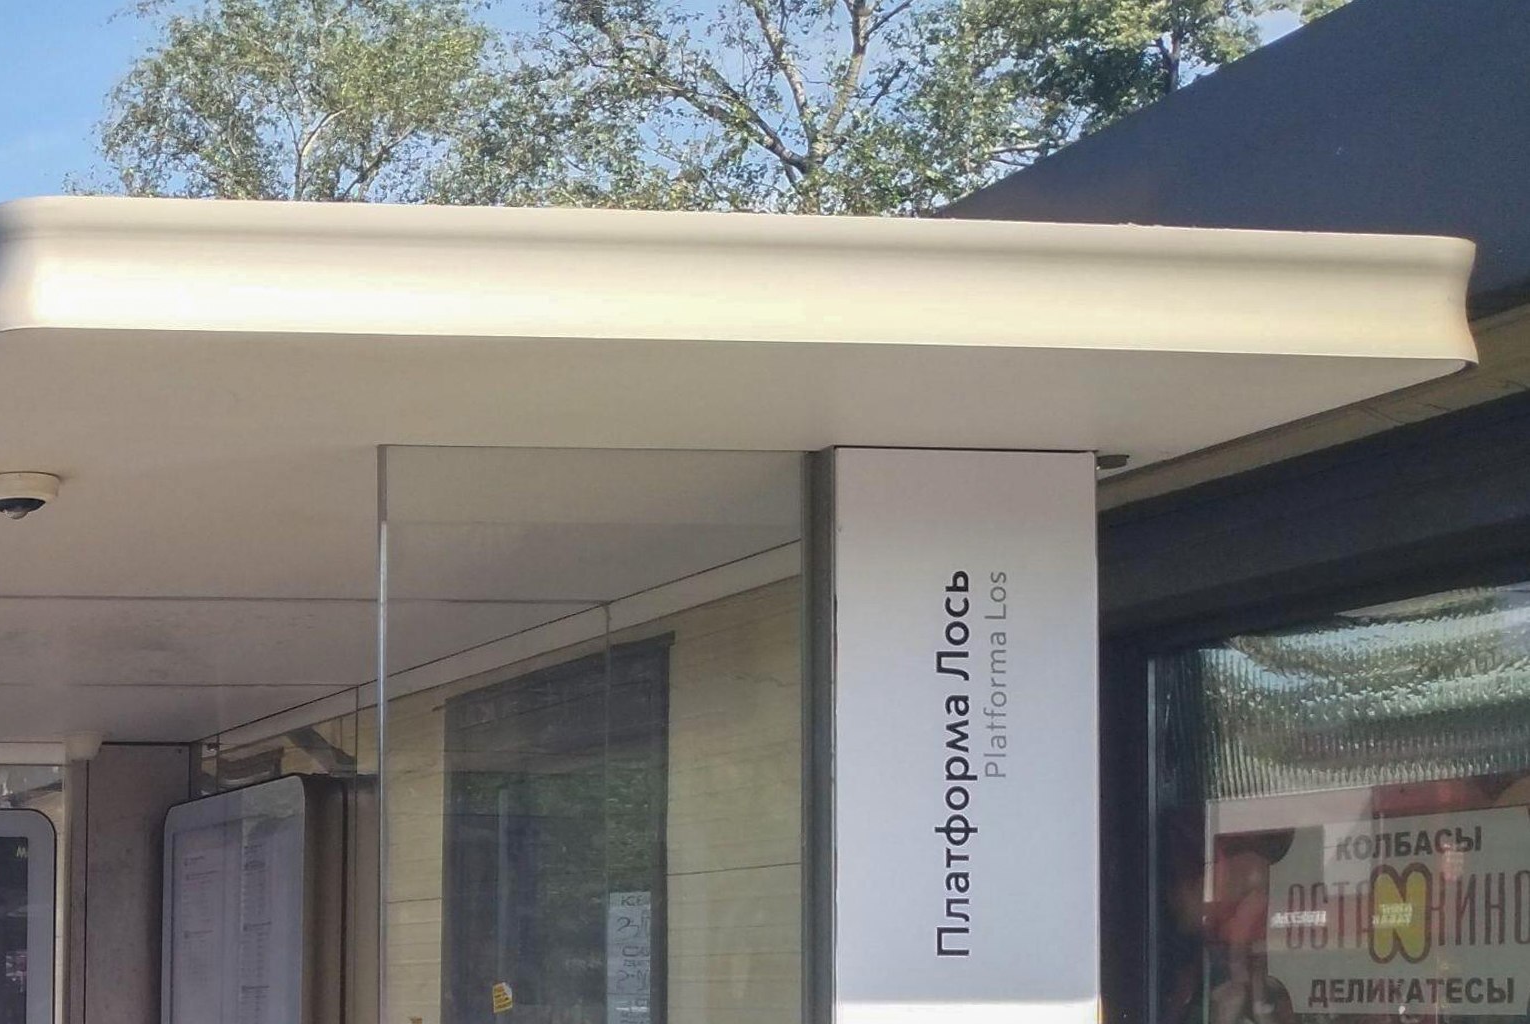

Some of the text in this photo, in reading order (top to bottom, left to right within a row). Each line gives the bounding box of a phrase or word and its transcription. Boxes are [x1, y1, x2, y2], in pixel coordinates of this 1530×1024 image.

[984, 571, 1008, 778] Platforma Los
[934, 570, 979, 957] Платформа Лось
[1335, 826, 1483, 862] КОЛБАСЫ
[1308, 977, 1515, 1008] ДЕЛИКАТЕСЫ
